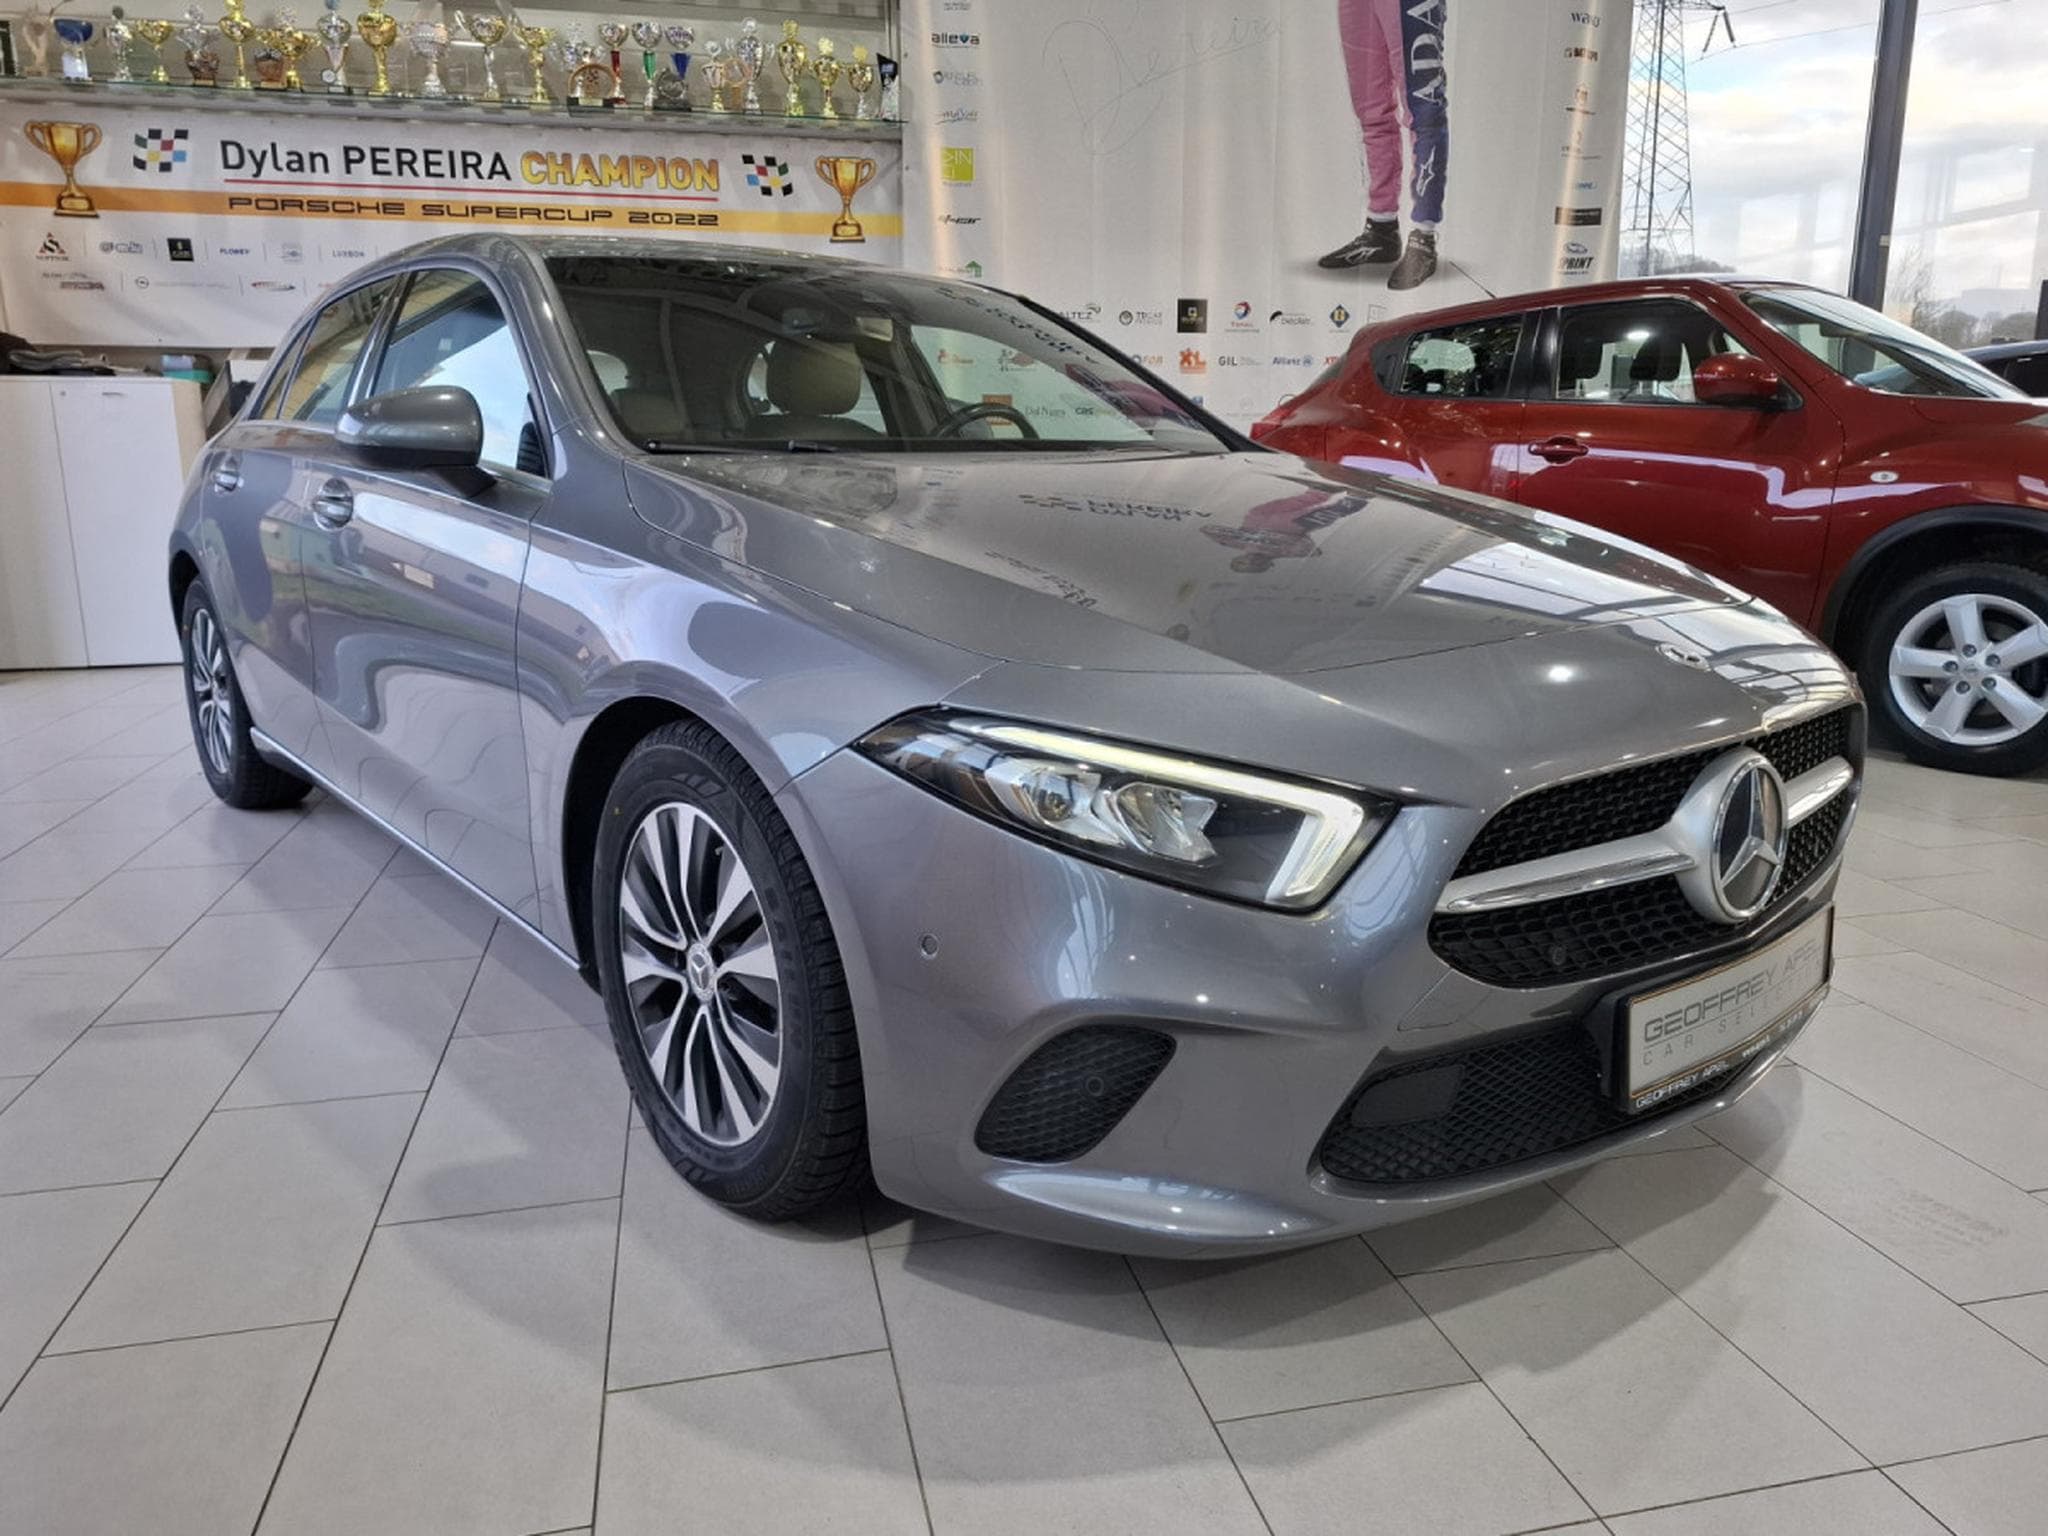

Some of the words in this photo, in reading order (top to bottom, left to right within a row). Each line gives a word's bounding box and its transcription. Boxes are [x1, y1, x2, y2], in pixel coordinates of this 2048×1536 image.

[219, 138, 330, 178] Dylan
[343, 145, 512, 181] PEREIRA
[520, 150, 720, 191] CHAMPION
[228, 196, 406, 216] PORSCHE
[420, 203, 613, 222] SUPERCUP
[628, 211, 719, 227] 2022
[1218, 356, 1238, 367] GIL
[1643, 964, 1777, 1043] GEOFFREY
